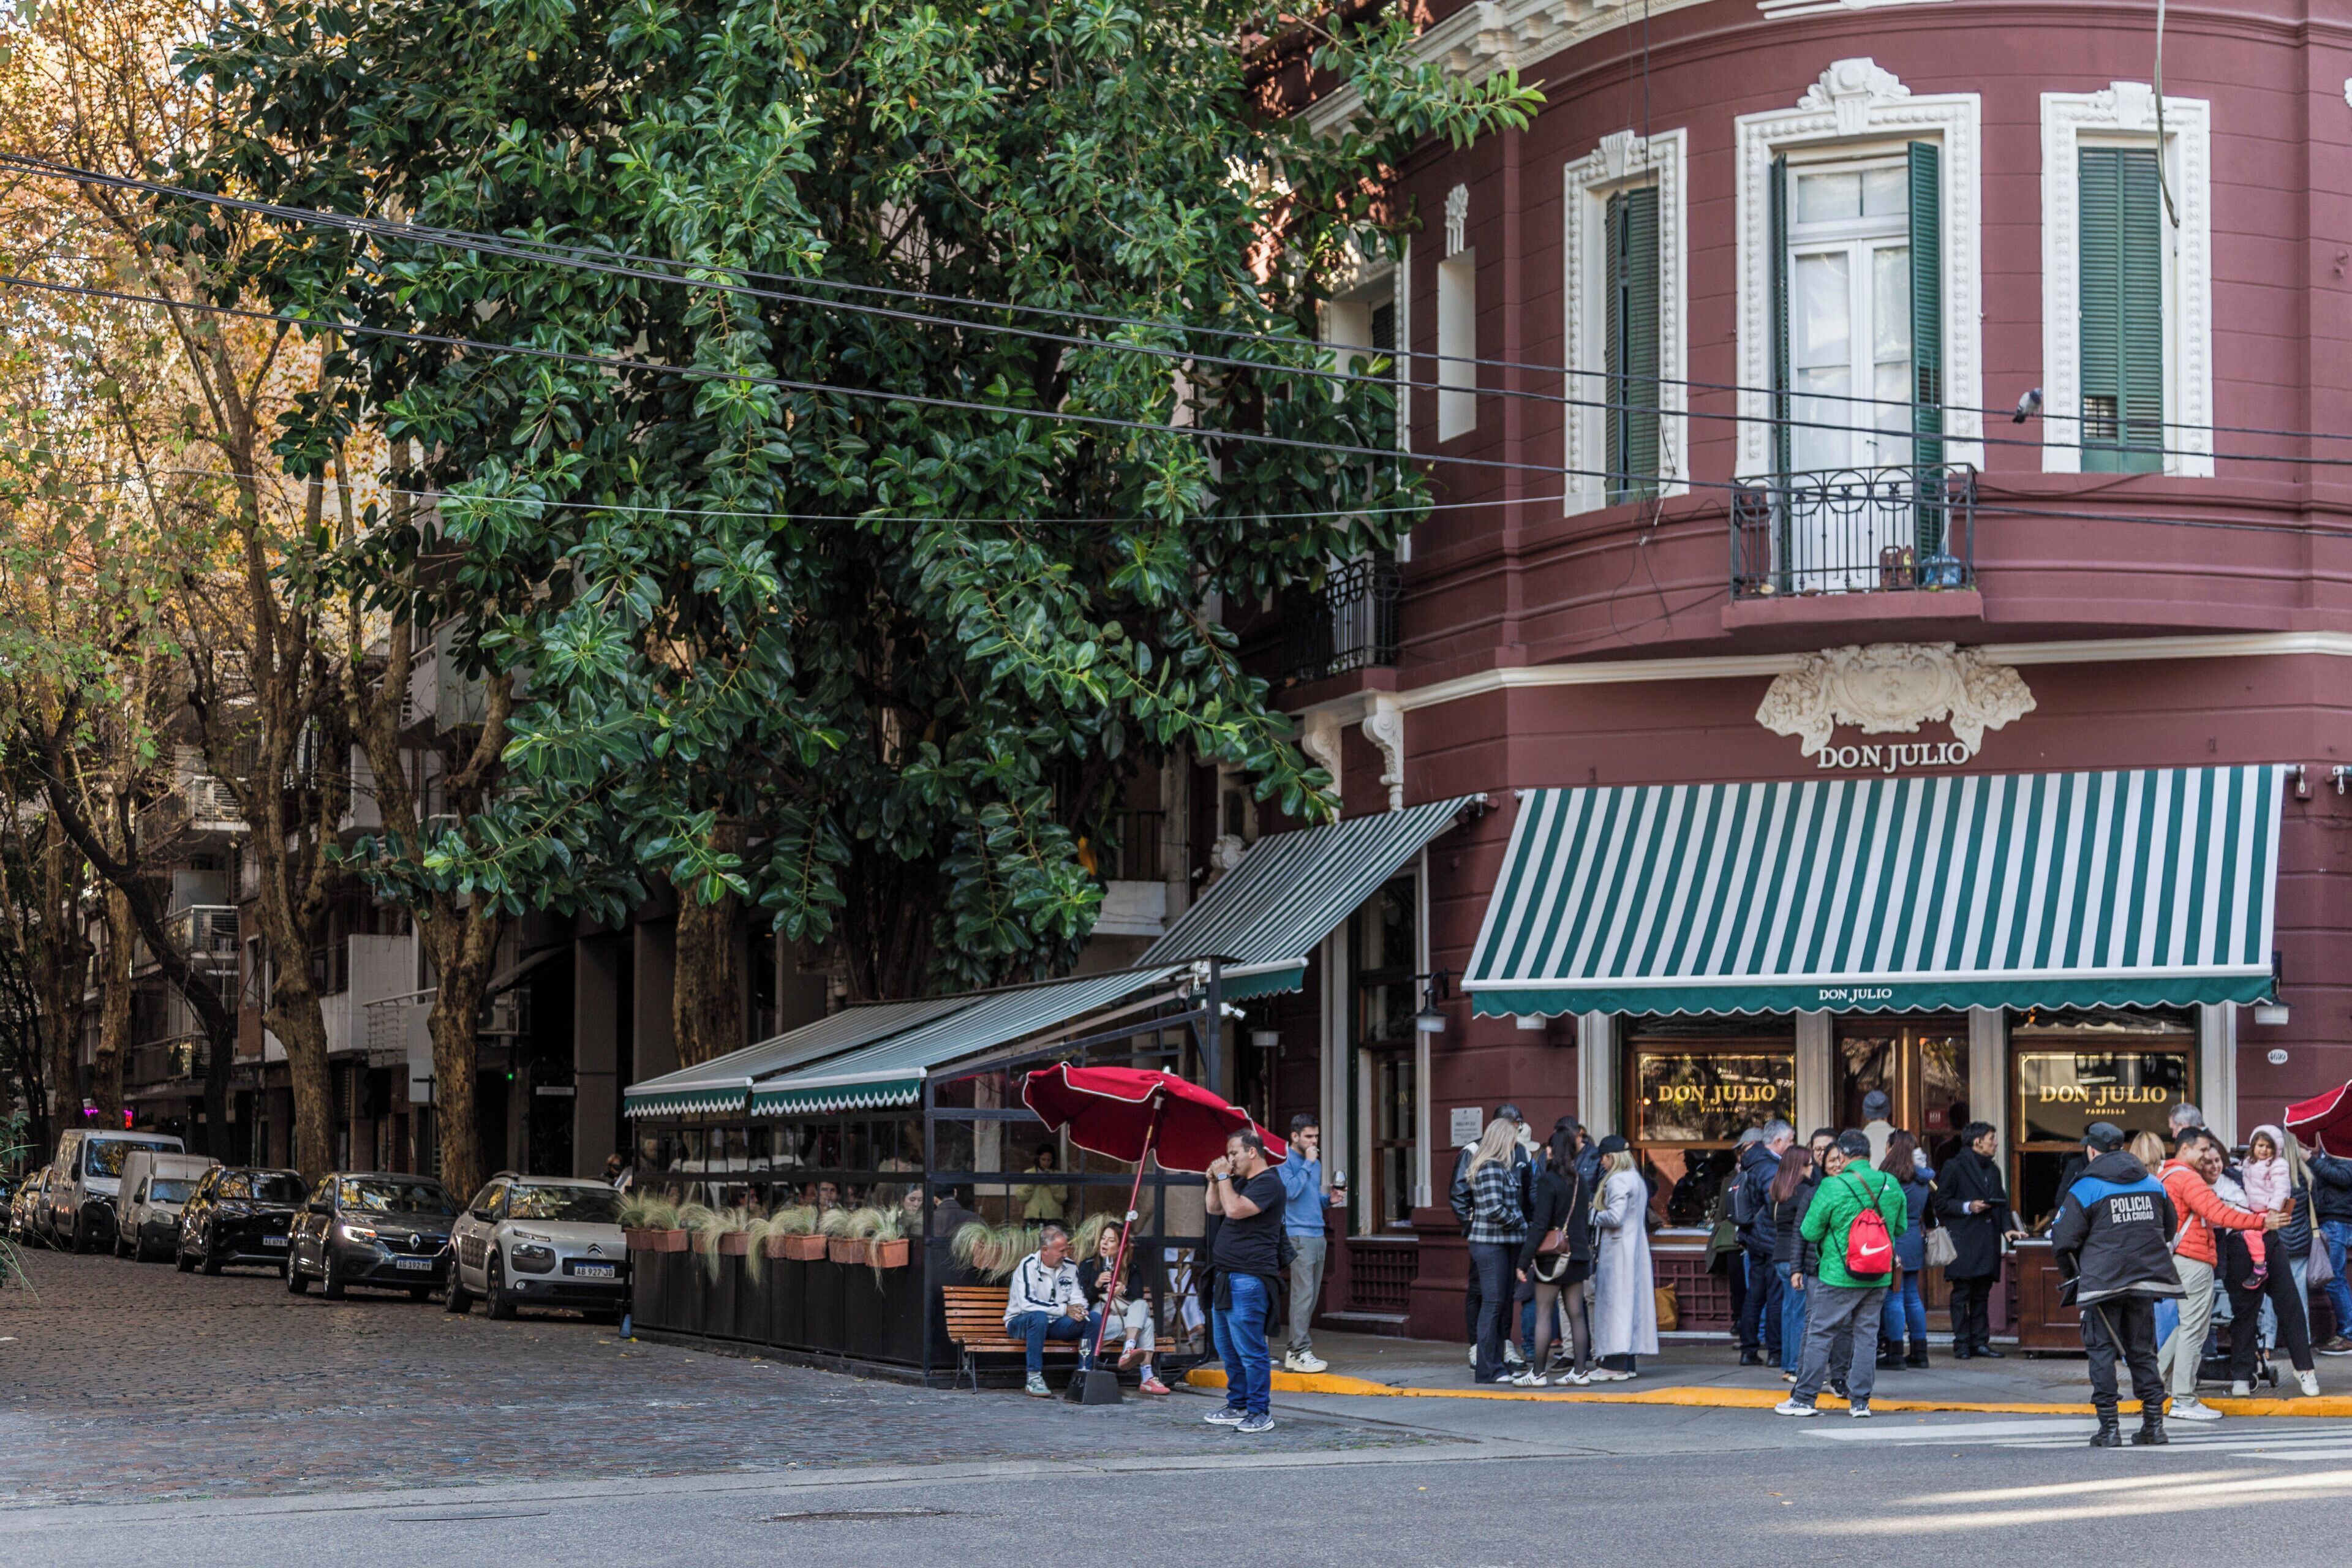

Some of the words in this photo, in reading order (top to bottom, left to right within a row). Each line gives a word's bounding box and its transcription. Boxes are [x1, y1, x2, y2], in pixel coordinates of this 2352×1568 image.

[1817, 744, 1883, 769] DON
[1882, 742, 1970, 774] JULIO
[1819, 989, 1848, 1000] DON
[1849, 988, 1892, 1003] JULIO
[1658, 1085, 1706, 1102] DON
[1710, 1085, 1777, 1105] JULIO
[2040, 1085, 2090, 1103] DON
[2095, 1085, 2167, 1107] JULIO
[2110, 1196, 2153, 1213] POLICIA
[2112, 1213, 2122, 1224] DE
[2122, 1212, 2132, 1223] LA
[2132, 1210, 2154, 1221] CIUDAD
[588, 1268, 601, 1276] 927
